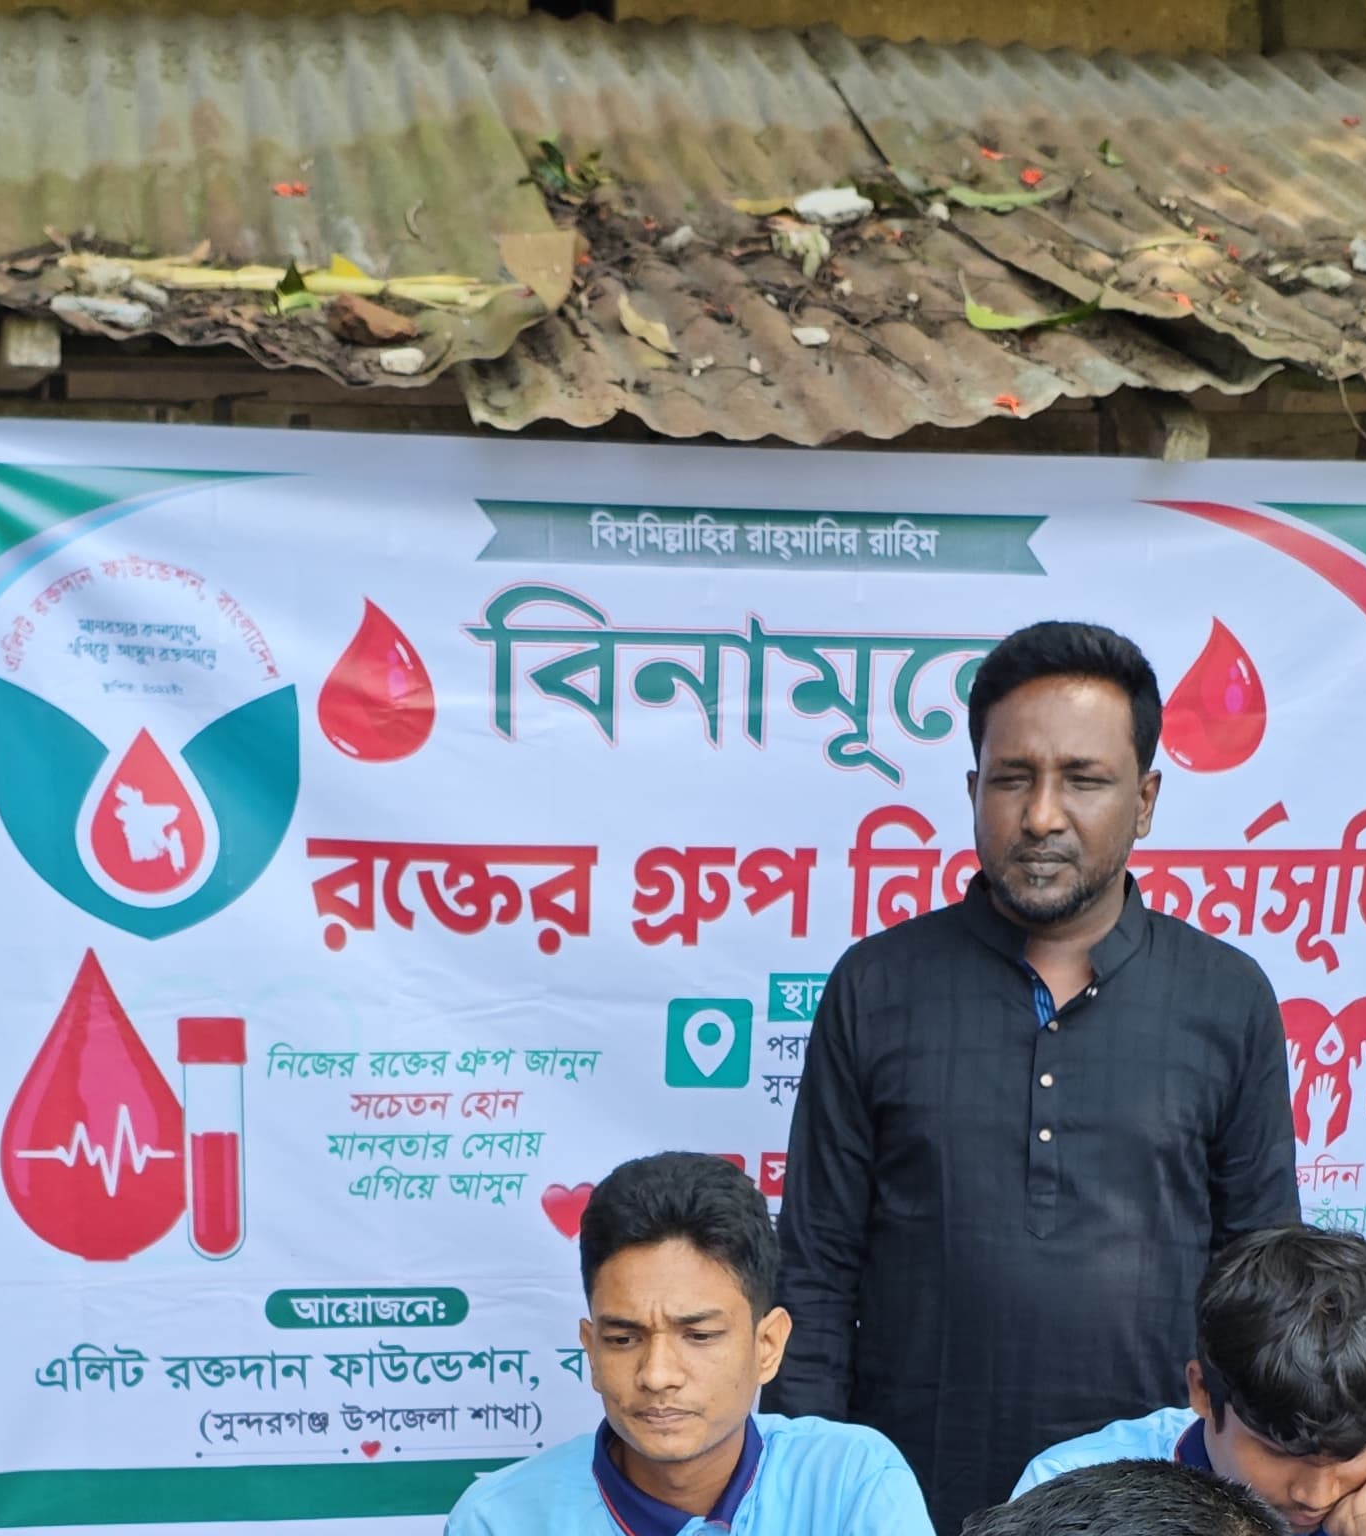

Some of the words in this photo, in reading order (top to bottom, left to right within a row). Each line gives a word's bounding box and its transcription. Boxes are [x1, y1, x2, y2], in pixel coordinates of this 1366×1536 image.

[867, 518, 941, 561] রাহিম
[307, 838, 599, 955] রক্তের
[633, 846, 818, 946] গ্রুপ
[267, 1042, 360, 1079] নিজের
[368, 1049, 451, 1078] রক্তের
[455, 1047, 515, 1077] গ্রুপ
[524, 1047, 602, 1082] জানুন
[349, 1092, 453, 1120] সচেতন
[460, 1088, 524, 1120] হোন
[326, 1130, 453, 1160] মানবতার
[462, 1128, 546, 1160] সেবায়
[348, 1165, 440, 1201] এগিয়ে
[449, 1171, 528, 1207] আসুন
[35, 1343, 149, 1392] এলিট
[161, 1350, 313, 1391] রক্তদান
[324, 1340, 540, 1392] ফাউন্ডেশন,
[198, 1408, 330, 1443] (সুন্দরগঞ্জ
[339, 1402, 460, 1433] উপজেলা
[466, 1401, 543, 1437] শাখা)
